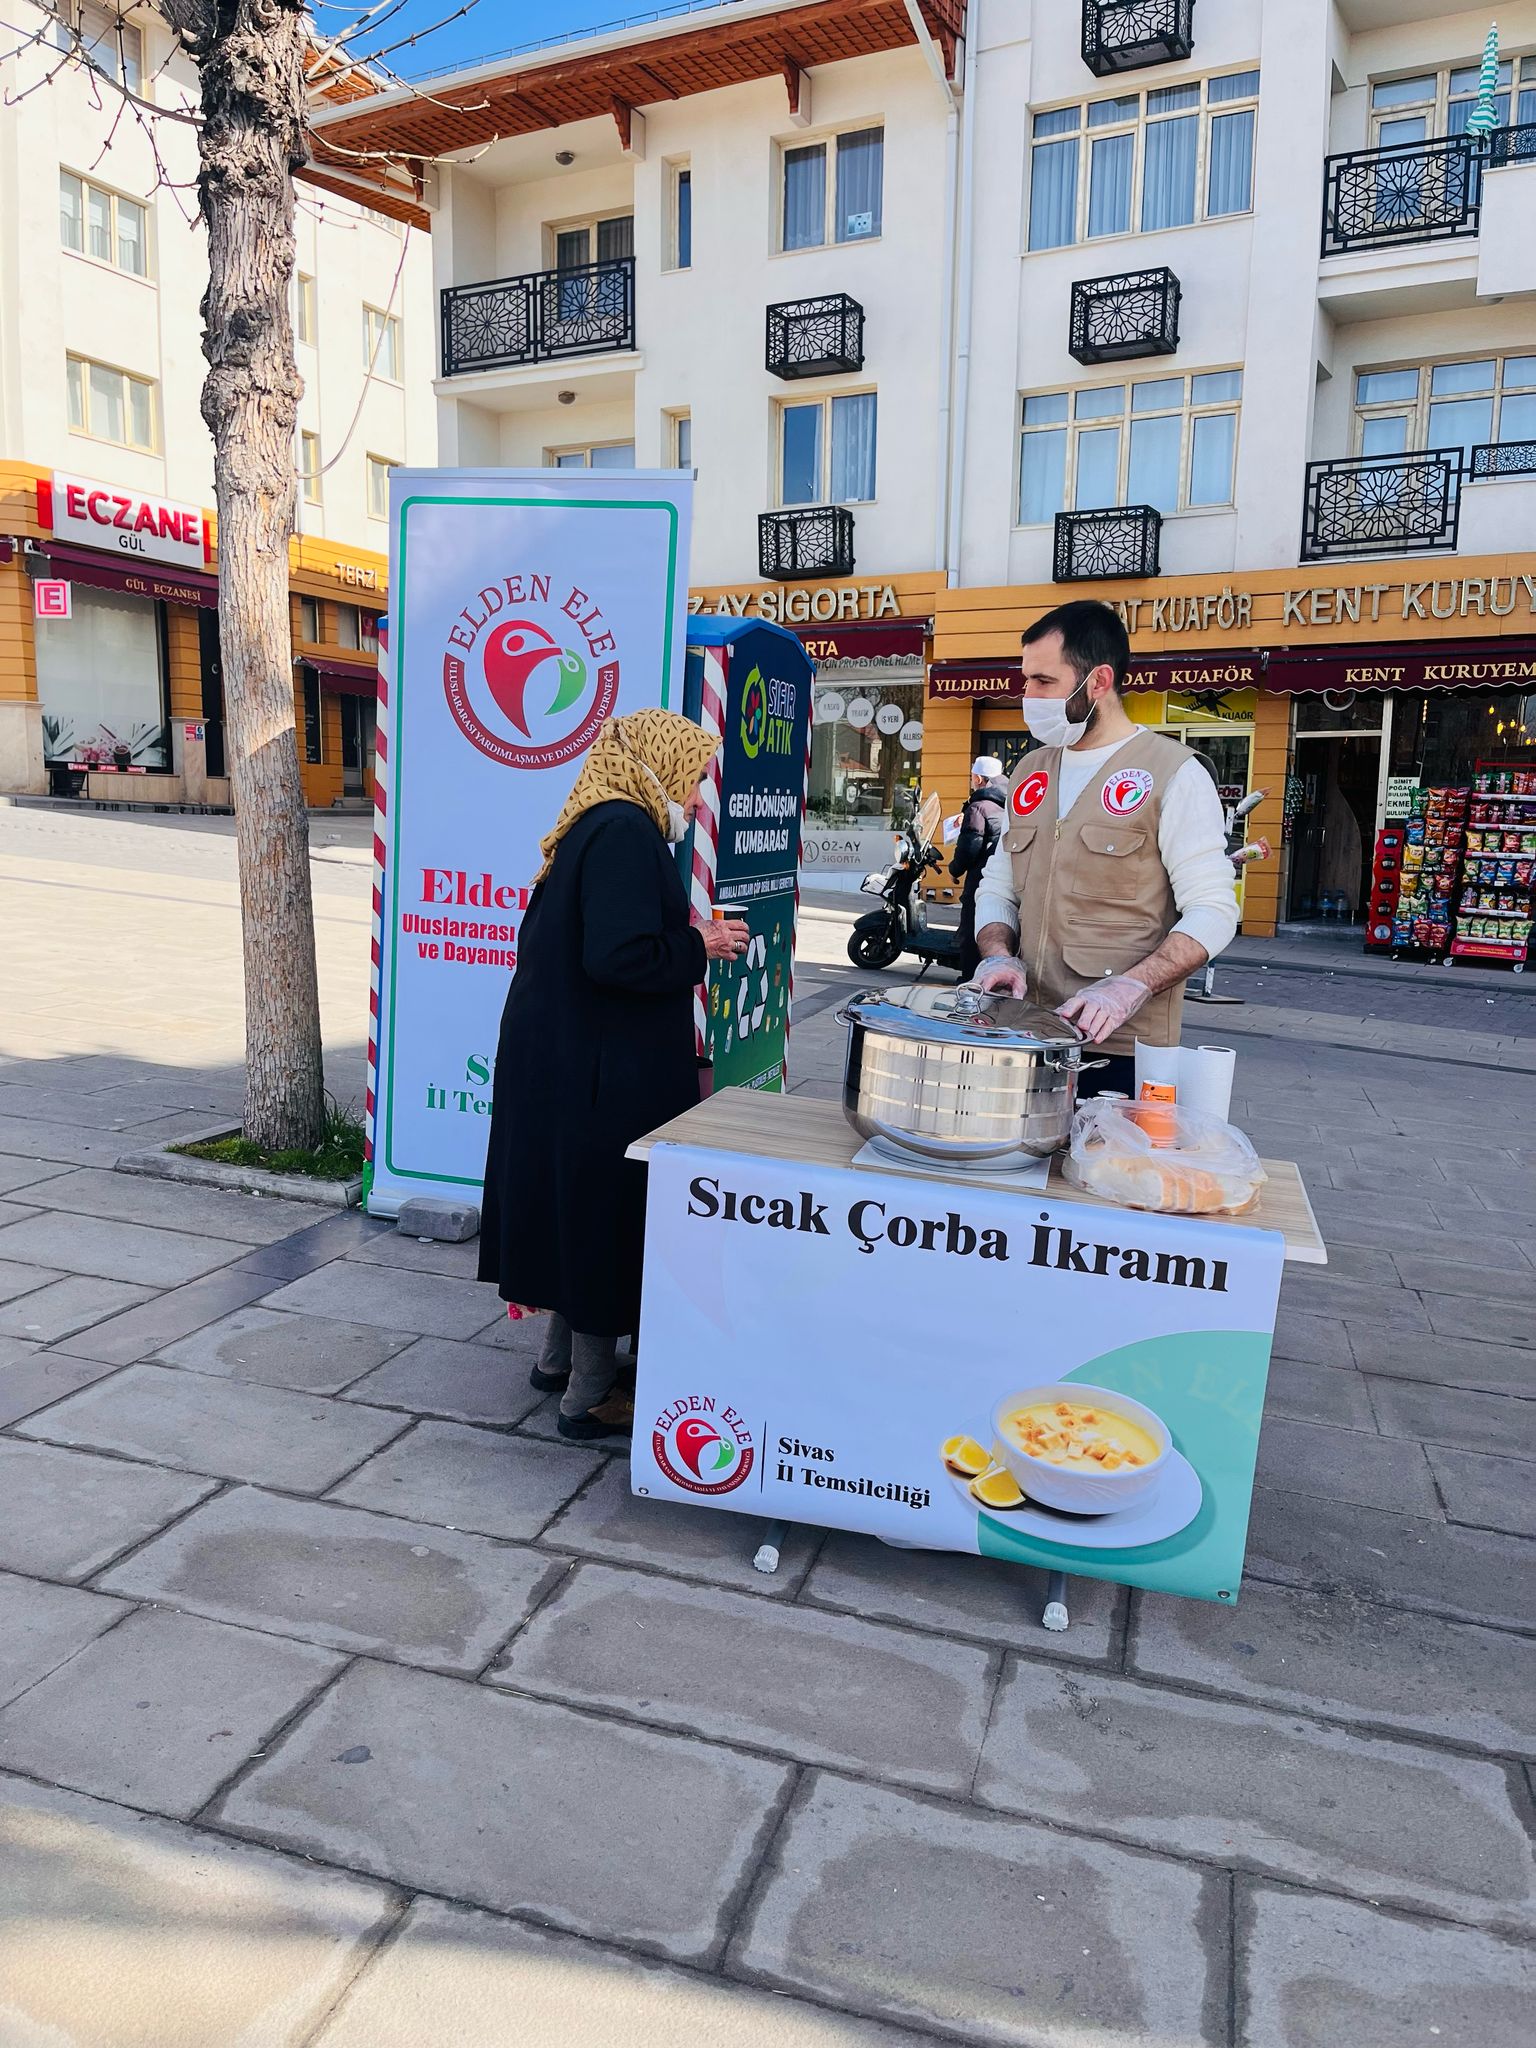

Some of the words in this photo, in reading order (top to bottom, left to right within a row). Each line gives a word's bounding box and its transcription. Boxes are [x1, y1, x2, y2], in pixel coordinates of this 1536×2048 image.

[67, 484, 200, 545] ECZANE
[118, 533, 146, 552] GÜL
[44, 587, 62, 610] E
[125, 577, 147, 592] GÜL
[154, 583, 201, 601] ECZANESİ
[1282, 583, 1390, 627] KENT
[447, 574, 552, 653] ELDEN
[560, 586, 617, 658] ELE
[1102, 598, 1142, 633] AT
[1151, 585, 1253, 632] KUAFÖR
[801, 640, 839, 656] RTA
[934, 677, 1011, 692] YILDIRIM
[1170, 665, 1255, 685] KUAFÖR
[1344, 667, 1406, 683] KENT
[449, 660, 478, 736] ULUSLARARASI
[475, 730, 541, 765] YARDIMLAŞMA
[541, 752, 555, 764] VE
[555, 720, 601, 759] DAYANIŞMA
[768, 678, 796, 720] SIFIR
[766, 718, 793, 755] ATIK
[1109, 769, 1141, 786] ELDEN
[1141, 774, 1153, 790] ELE
[728, 785, 754, 818] GERİ
[754, 787, 798, 825] DÖNÜŞÜM
[734, 829, 789, 855] KUMBARASI
[402, 913, 515, 942] Uluslararası
[418, 942, 439, 960] ve
[466, 1053, 496, 1088] S
[426, 1083, 446, 1110] İl
[453, 1090, 493, 1116] Te
[687, 1176, 831, 1235] Sıcak
[848, 1200, 1010, 1262] Çorba
[1027, 1211, 1229, 1293] İkramı
[655, 1395, 716, 1432] ELDEN
[720, 1406, 753, 1445] ELE
[778, 1436, 835, 1462] Sivas
[776, 1459, 794, 1482] İl
[800, 1467, 931, 1510] Temsilciliği
